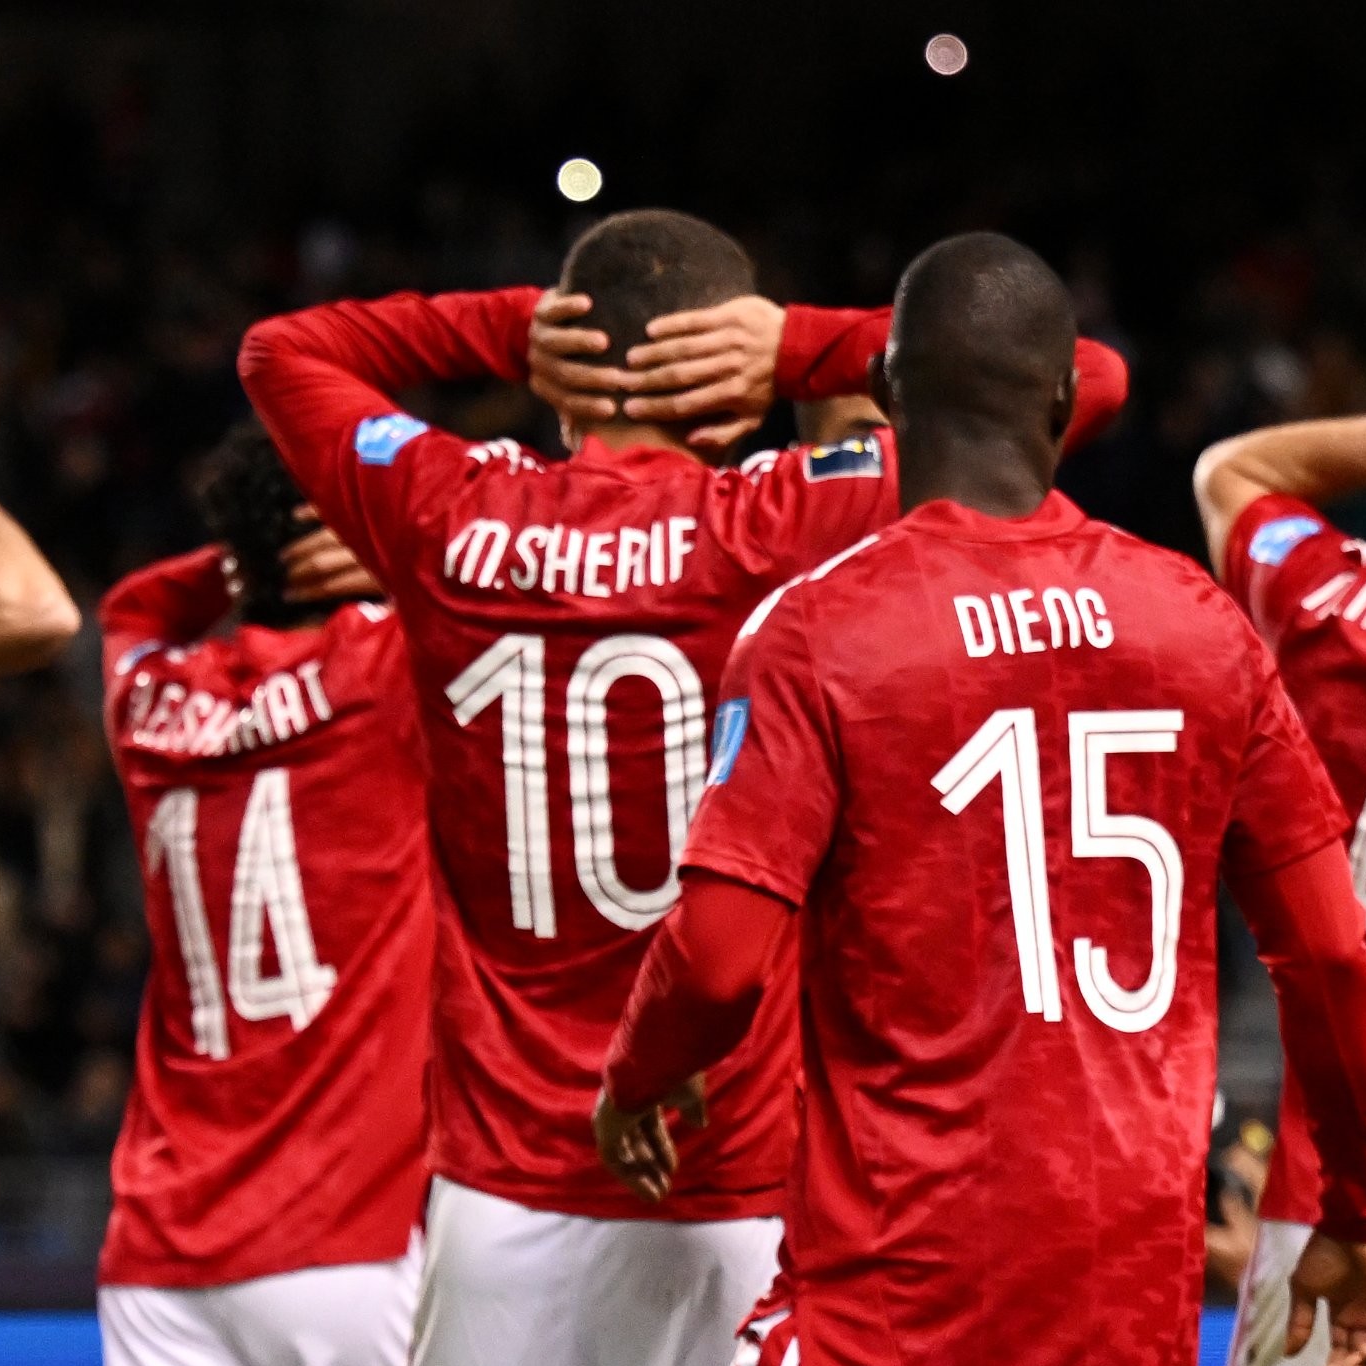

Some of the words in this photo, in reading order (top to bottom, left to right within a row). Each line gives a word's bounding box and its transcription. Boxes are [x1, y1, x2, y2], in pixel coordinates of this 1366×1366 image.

[444, 517, 699, 598] M.SHERIF
[953, 587, 1115, 658] DIENG
[146, 768, 338, 1060] 14
[444, 633, 706, 938] 10
[930, 707, 1185, 1034] 15
